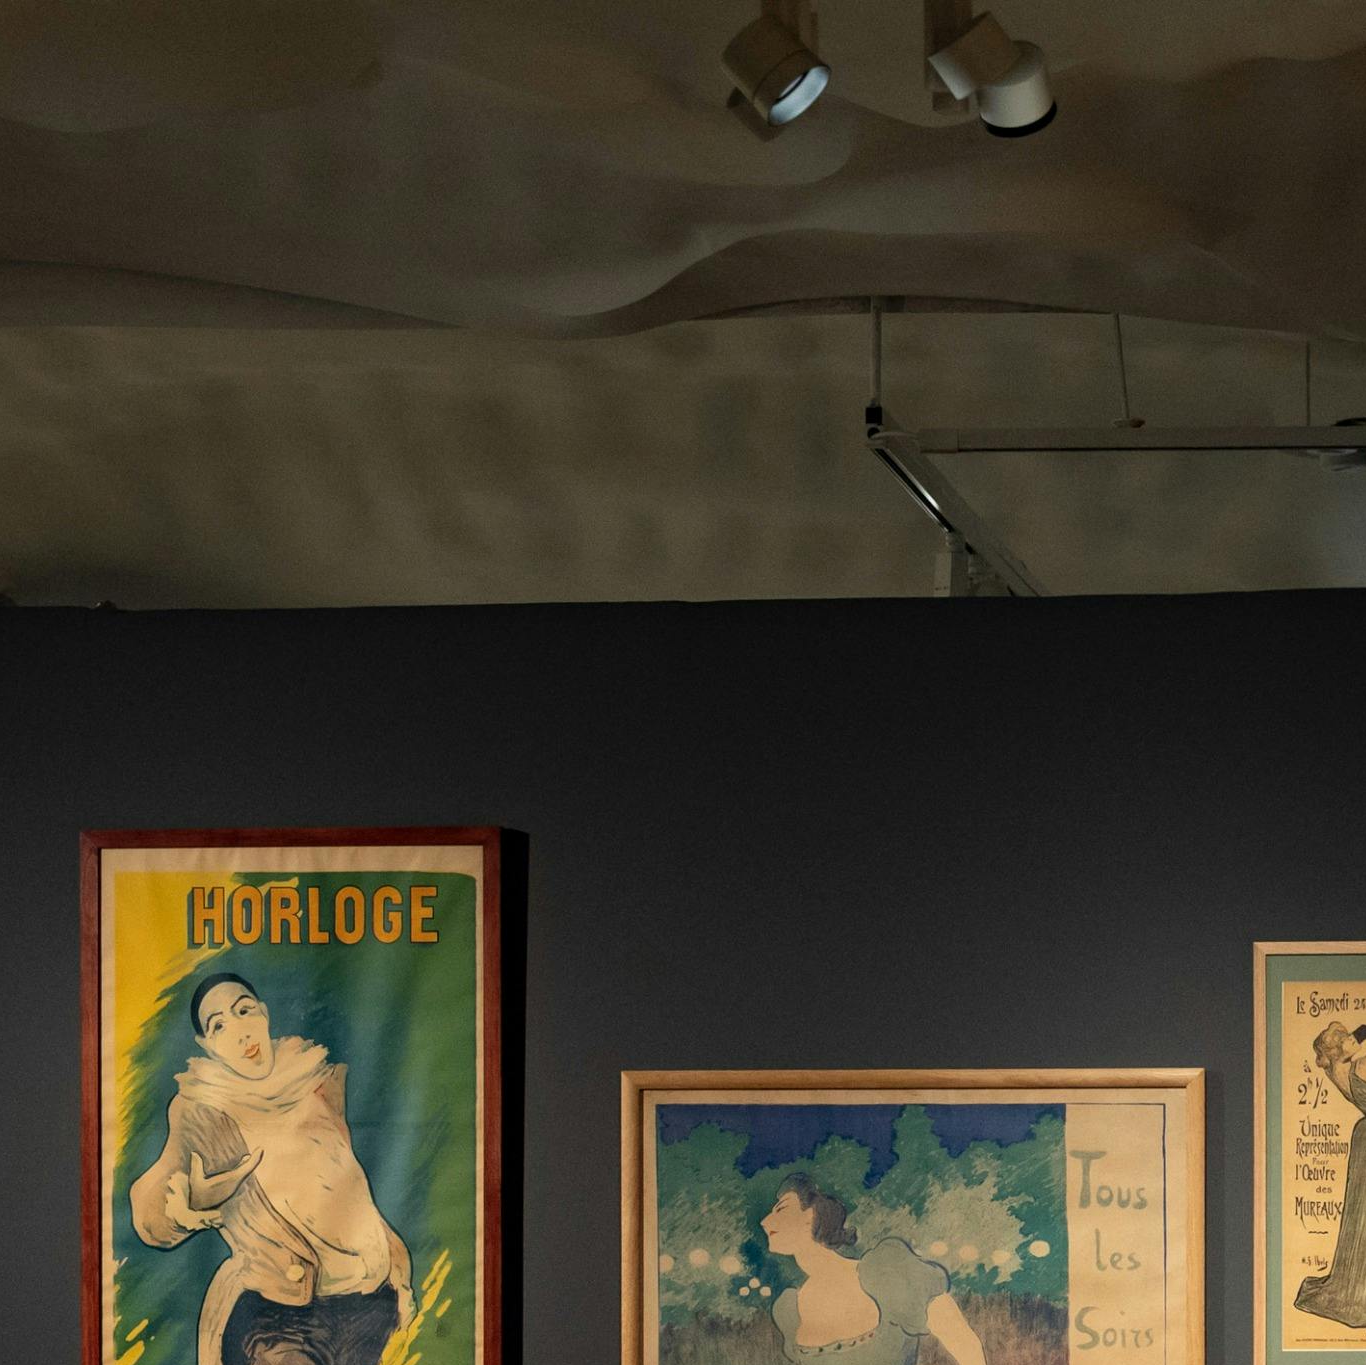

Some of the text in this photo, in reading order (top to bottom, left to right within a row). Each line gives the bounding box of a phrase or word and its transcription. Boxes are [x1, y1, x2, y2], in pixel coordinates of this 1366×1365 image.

[189, 885, 439, 947] HORLOGE
[1309, 991, 1349, 1017] Samedi
[1299, 1117, 1340, 1140] Unique
[1069, 1150, 1148, 1209] Tous
[1315, 1185, 1332, 1193] des
[1095, 1228, 1141, 1271] les
[1075, 1306, 1154, 1350] Soirs
